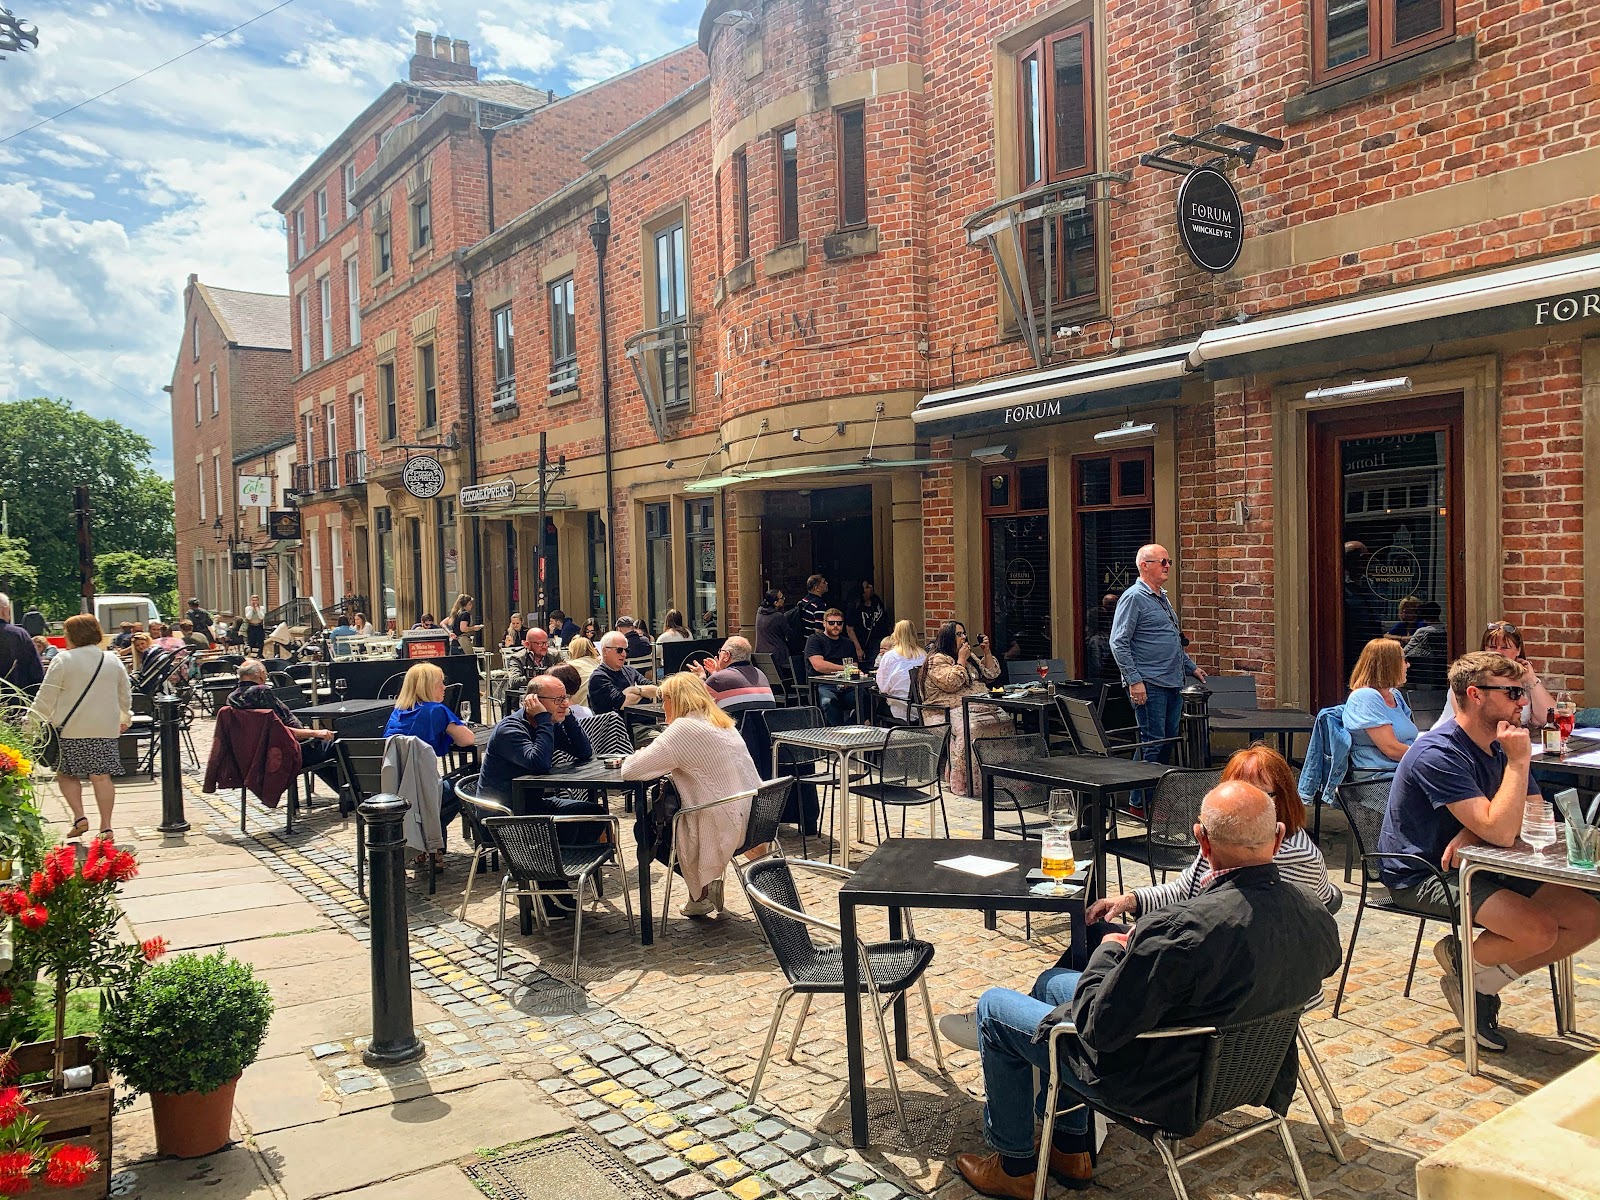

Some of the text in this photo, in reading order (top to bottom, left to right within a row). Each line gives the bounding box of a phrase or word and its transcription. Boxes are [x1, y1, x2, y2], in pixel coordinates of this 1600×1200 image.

[1191, 203, 1232, 223] FORUM
[1192, 224, 1233, 239] WINCKLEY ST.
[727, 309, 817, 360] FORUM
[1004, 400, 1061, 424] FORUM
[462, 485, 509, 502] PIZZAEXPRESS
[1375, 565, 1411, 574] FORUM
